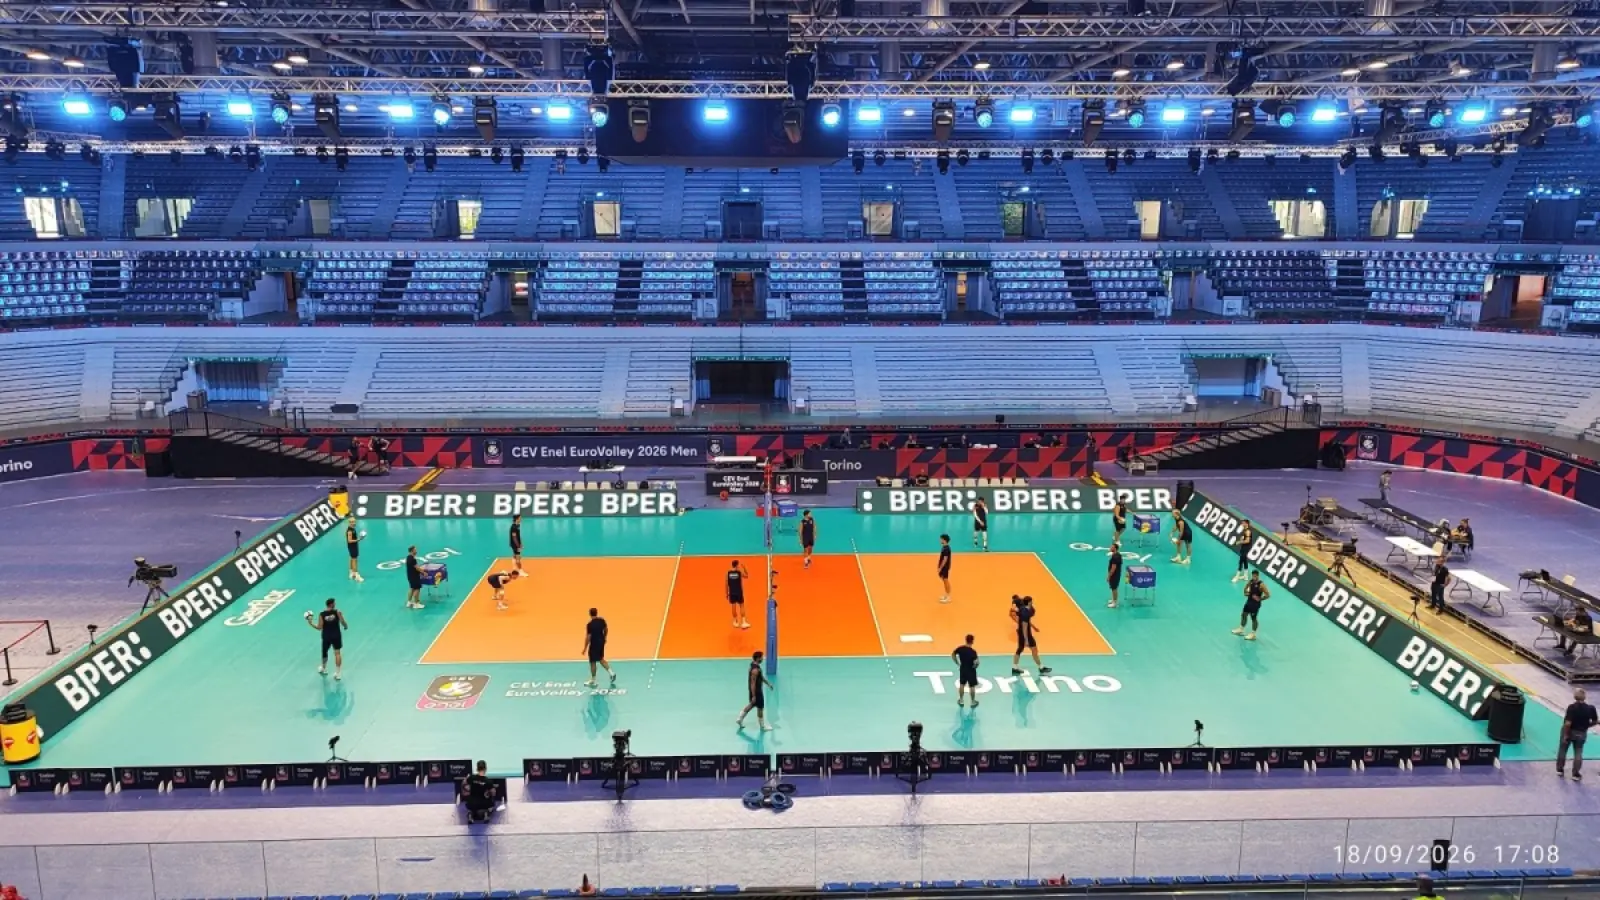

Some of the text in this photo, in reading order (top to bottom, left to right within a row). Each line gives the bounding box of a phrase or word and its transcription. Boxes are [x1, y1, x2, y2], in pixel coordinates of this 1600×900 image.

[511, 445, 697, 460] CEV Enel EuroVolley 2026 Men
[822, 459, 862, 471] Torino
[601, 492, 676, 515] BPER
[1097, 488, 1173, 510] BPER
[509, 681, 542, 689] CEV
[912, 669, 1122, 695] Torino
[504, 688, 587, 698] EuroVolley
